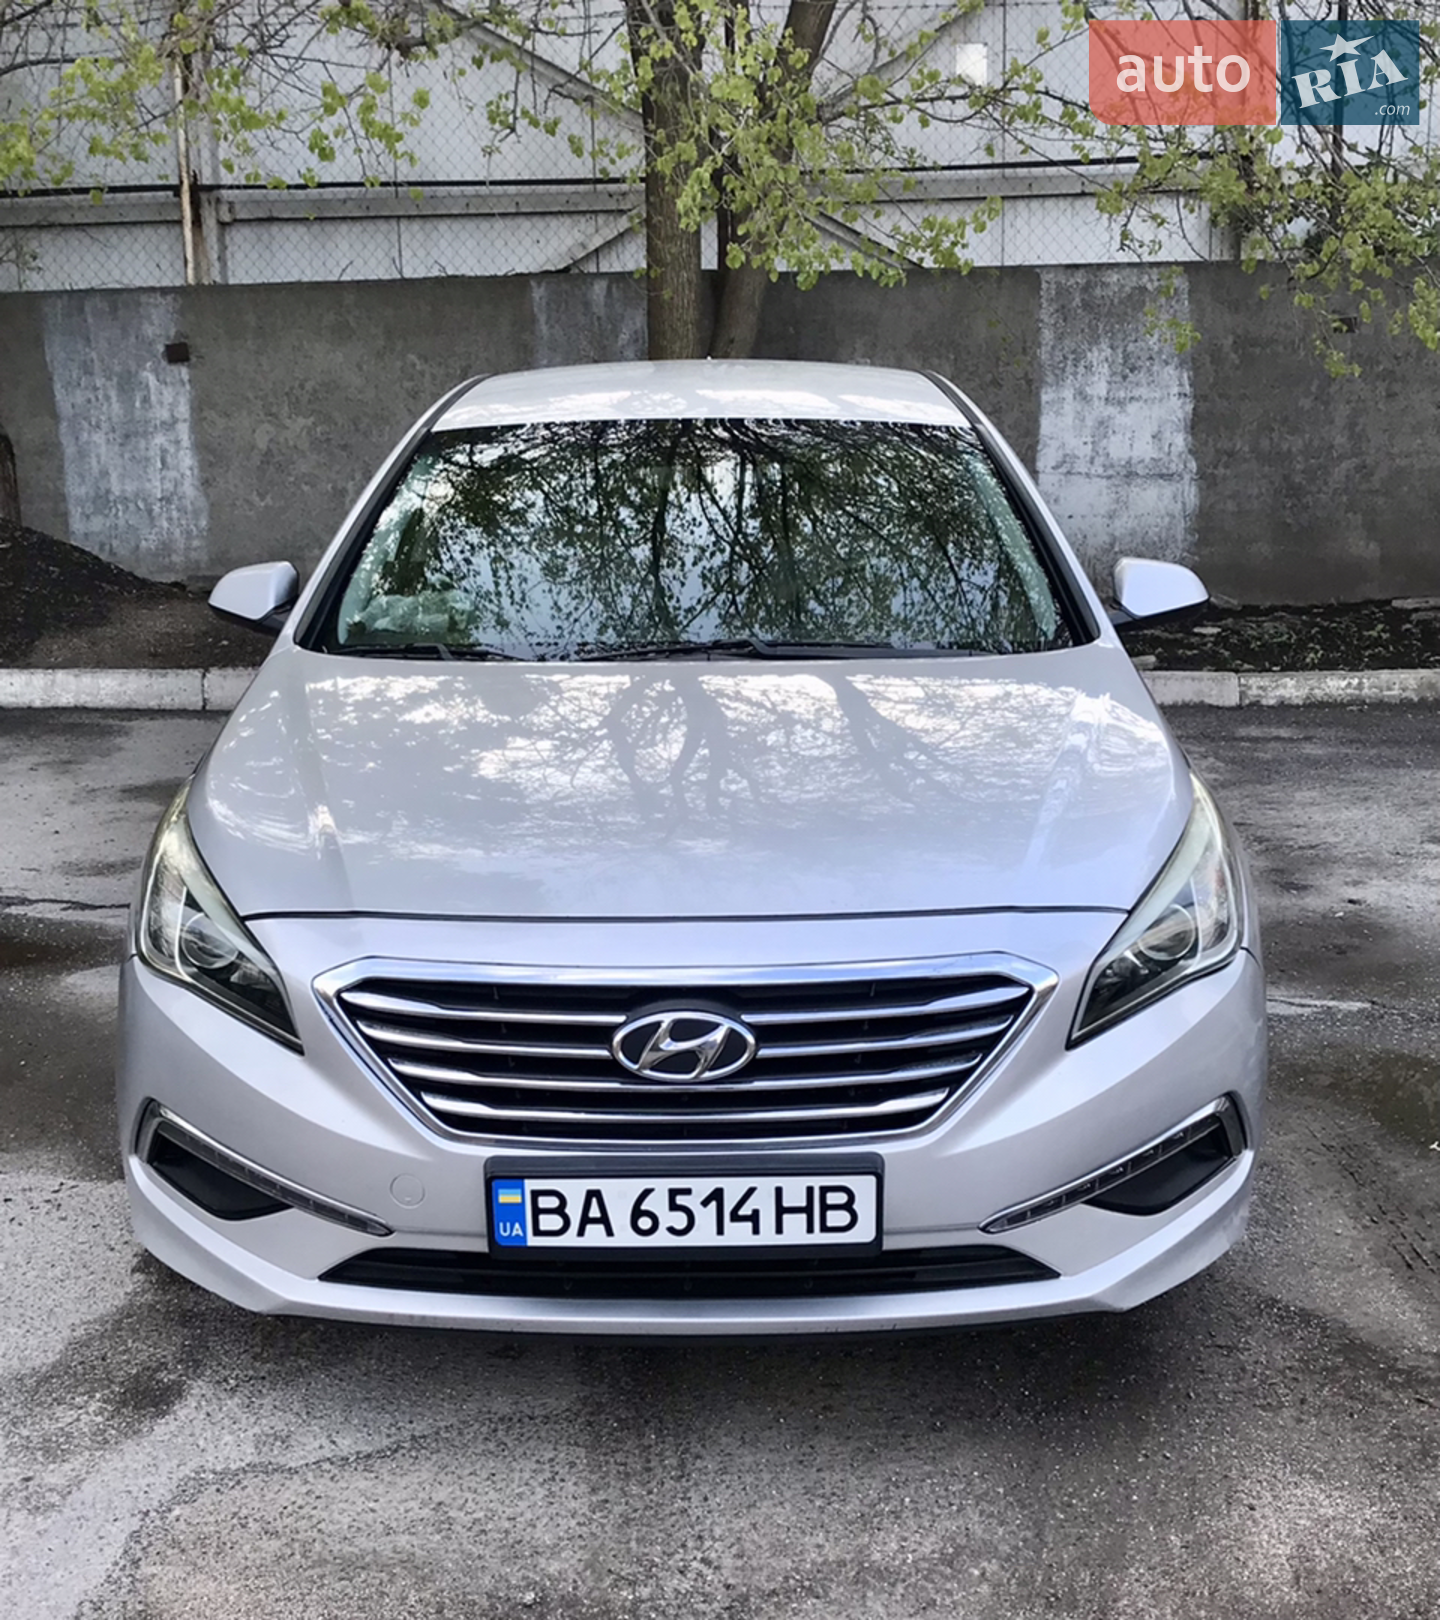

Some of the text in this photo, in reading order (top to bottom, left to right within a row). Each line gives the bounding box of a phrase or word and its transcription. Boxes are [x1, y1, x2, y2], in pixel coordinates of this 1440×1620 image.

[530, 1185, 859, 1238] BA 6514 HB
[499, 1221, 524, 1238] UA
